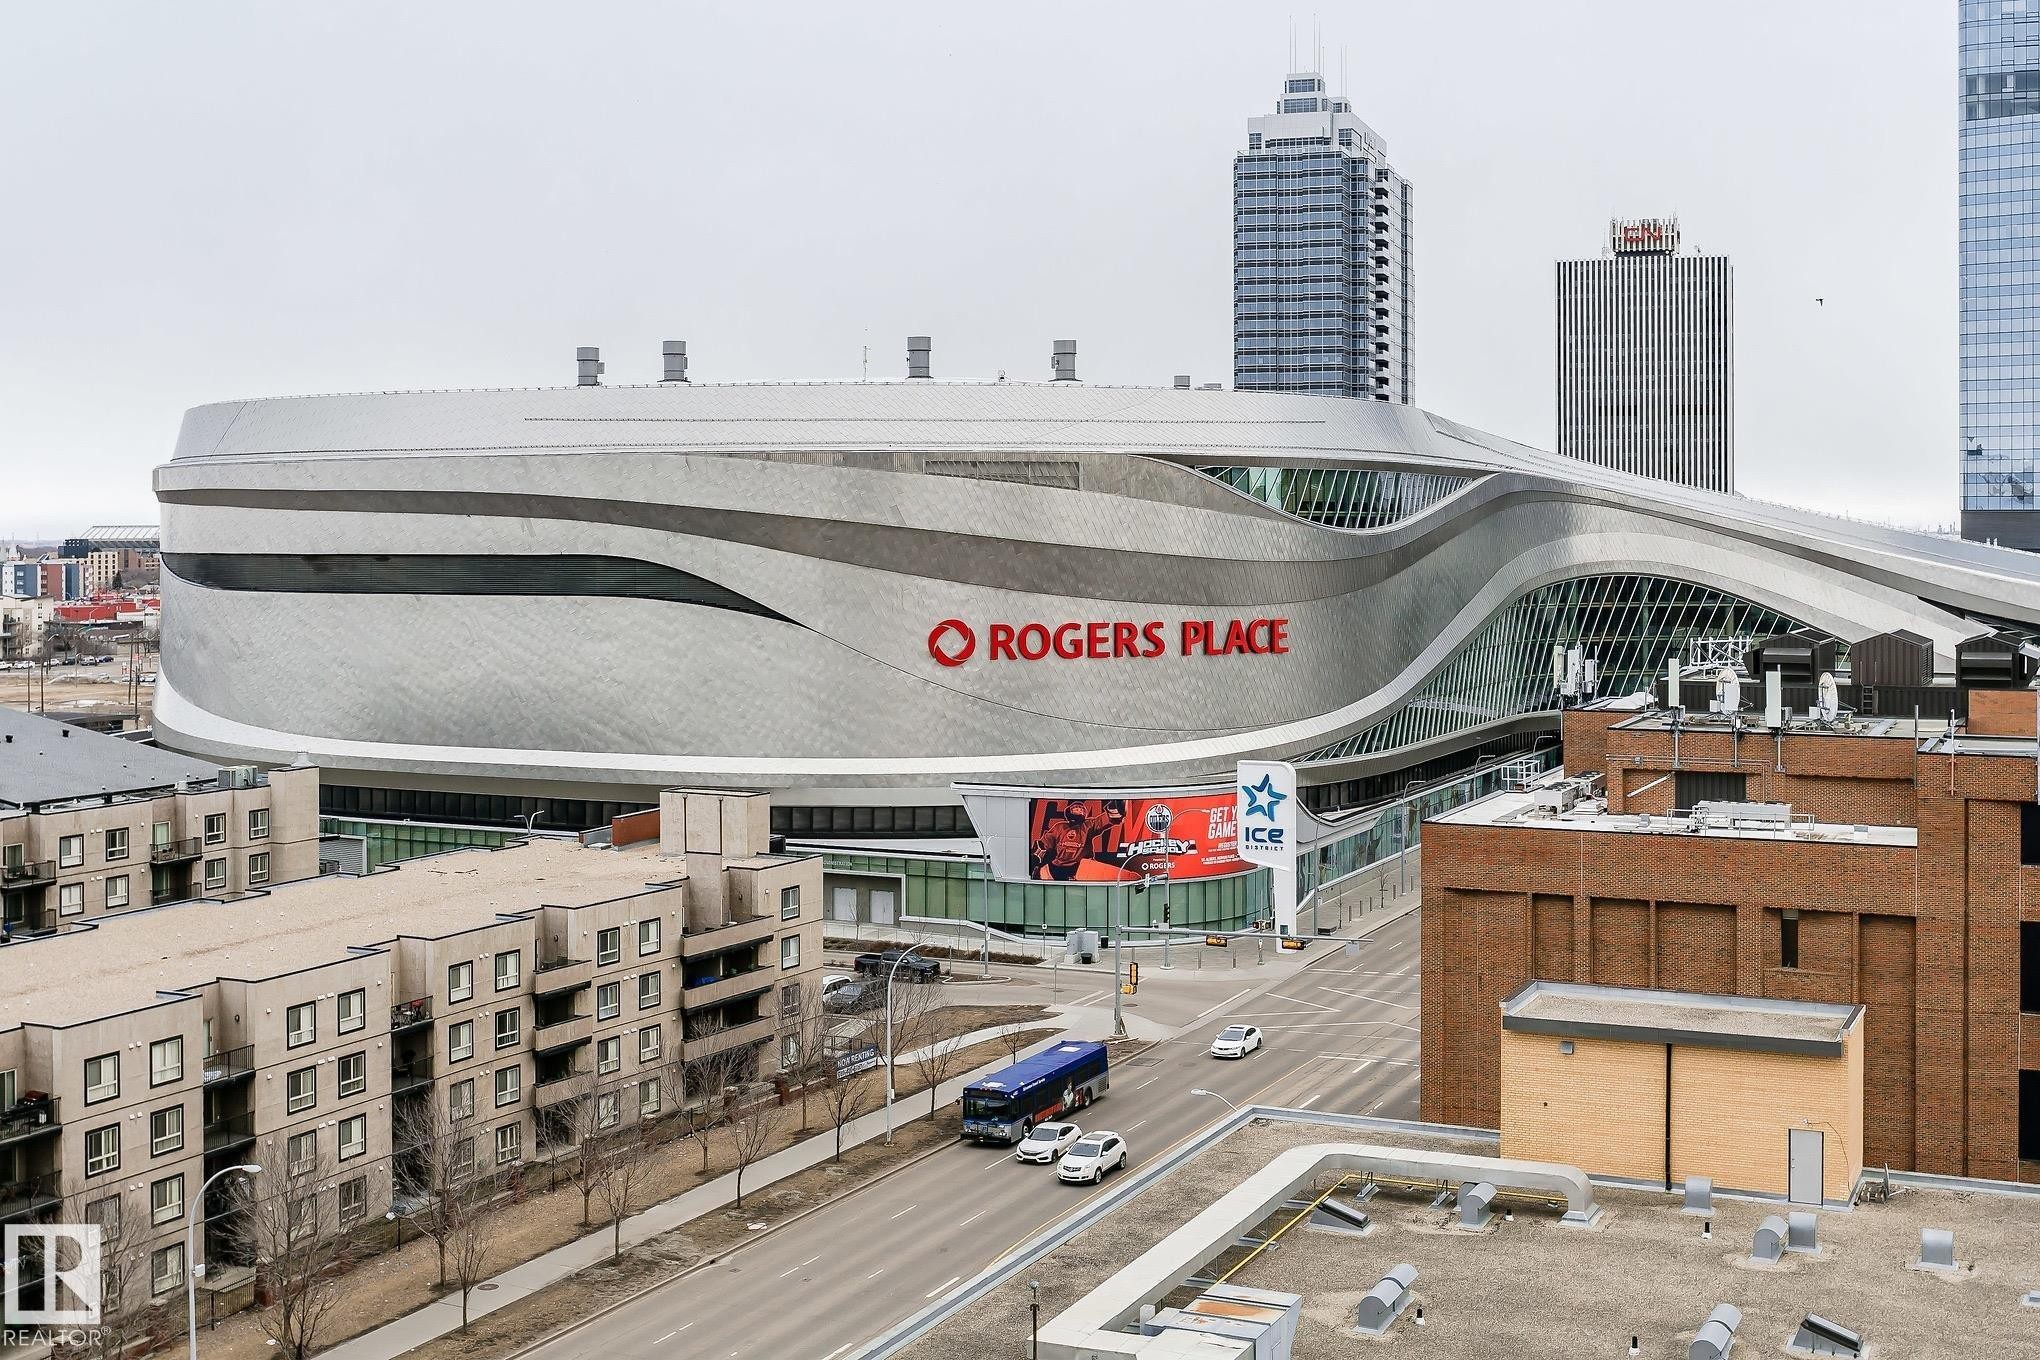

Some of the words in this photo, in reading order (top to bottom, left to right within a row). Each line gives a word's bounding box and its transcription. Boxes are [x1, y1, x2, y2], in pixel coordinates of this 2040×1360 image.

[1623, 224, 1662, 242] CN
[989, 622, 1166, 661] ROGERS
[1181, 618, 1289, 657] PLACE
[1210, 806, 1230, 824] GET
[1245, 827, 1284, 844] ICE
[1128, 839, 1189, 856] HOCKEY
[1245, 844, 1284, 852] DISTRICT
[1149, 862, 1176, 870] ROGERS
